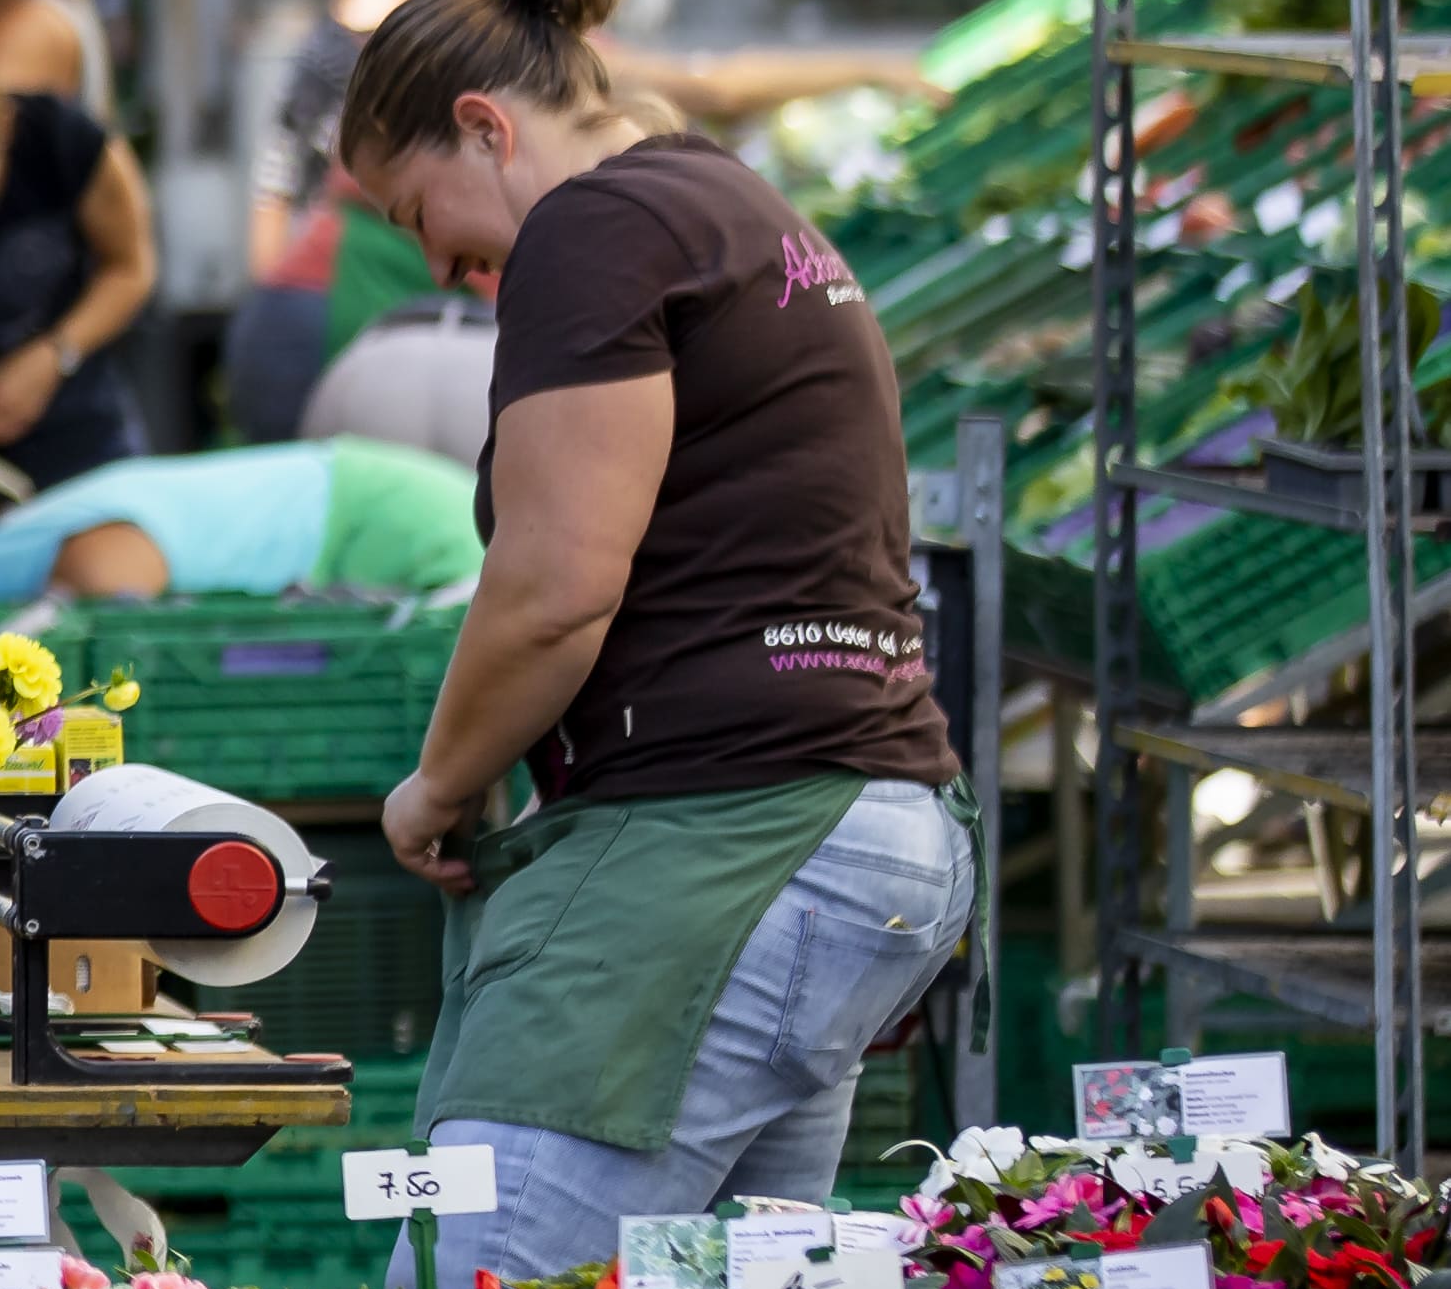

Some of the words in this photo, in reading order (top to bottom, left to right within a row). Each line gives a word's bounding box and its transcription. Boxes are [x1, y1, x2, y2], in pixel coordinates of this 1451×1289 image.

[764, 621, 822, 647] 8610
[825, 620, 872, 650] Uster
[378, 1171, 441, 1199] 7.50
